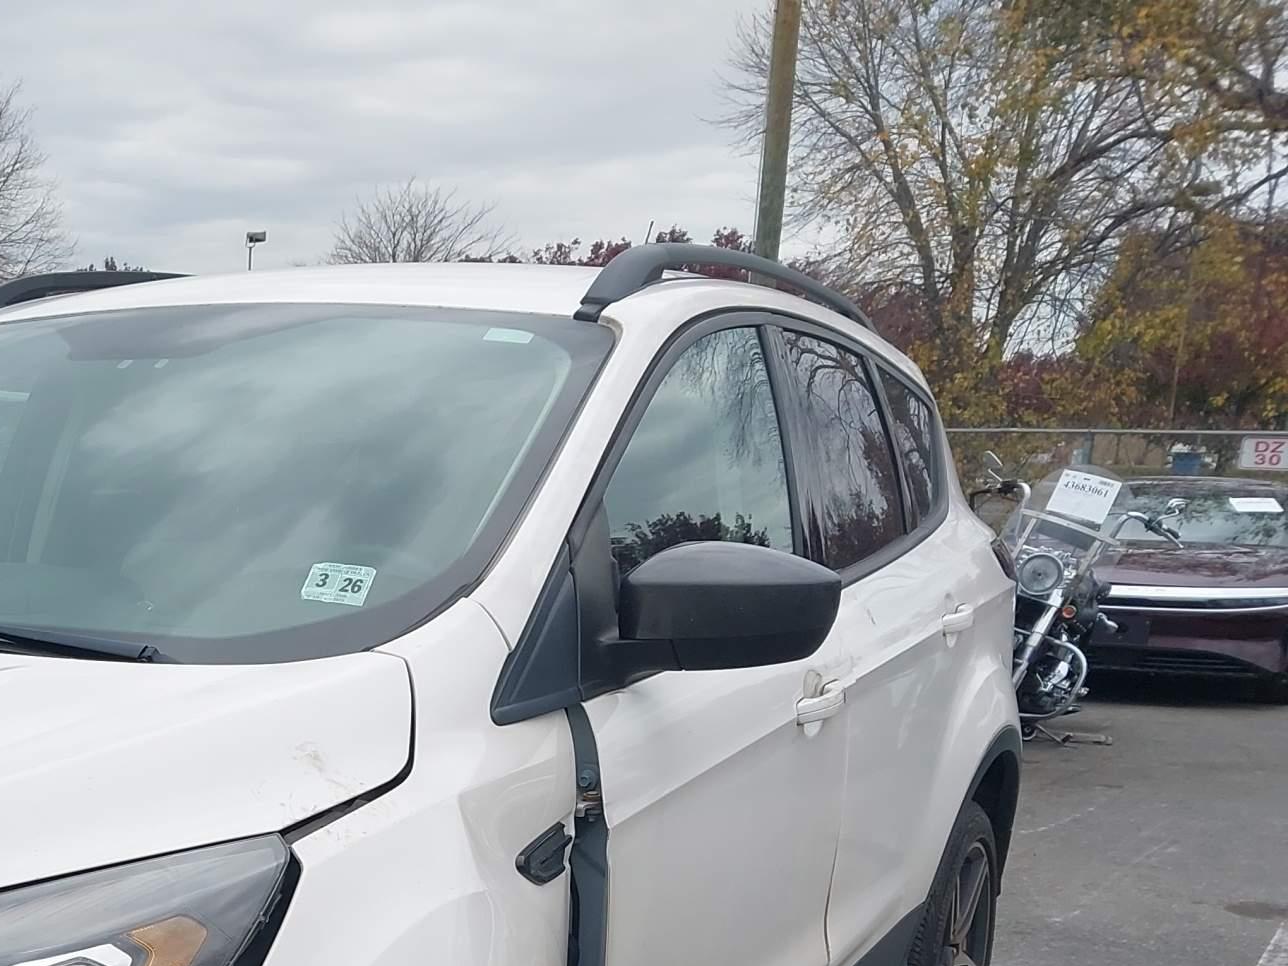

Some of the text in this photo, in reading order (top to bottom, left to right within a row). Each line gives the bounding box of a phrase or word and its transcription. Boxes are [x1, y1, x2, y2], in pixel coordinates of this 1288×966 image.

[1255, 441, 1286, 453] DZ
[1254, 453, 1281, 465] 30
[1064, 480, 1110, 498] 43683061
[315, 573, 364, 594] 3 26
